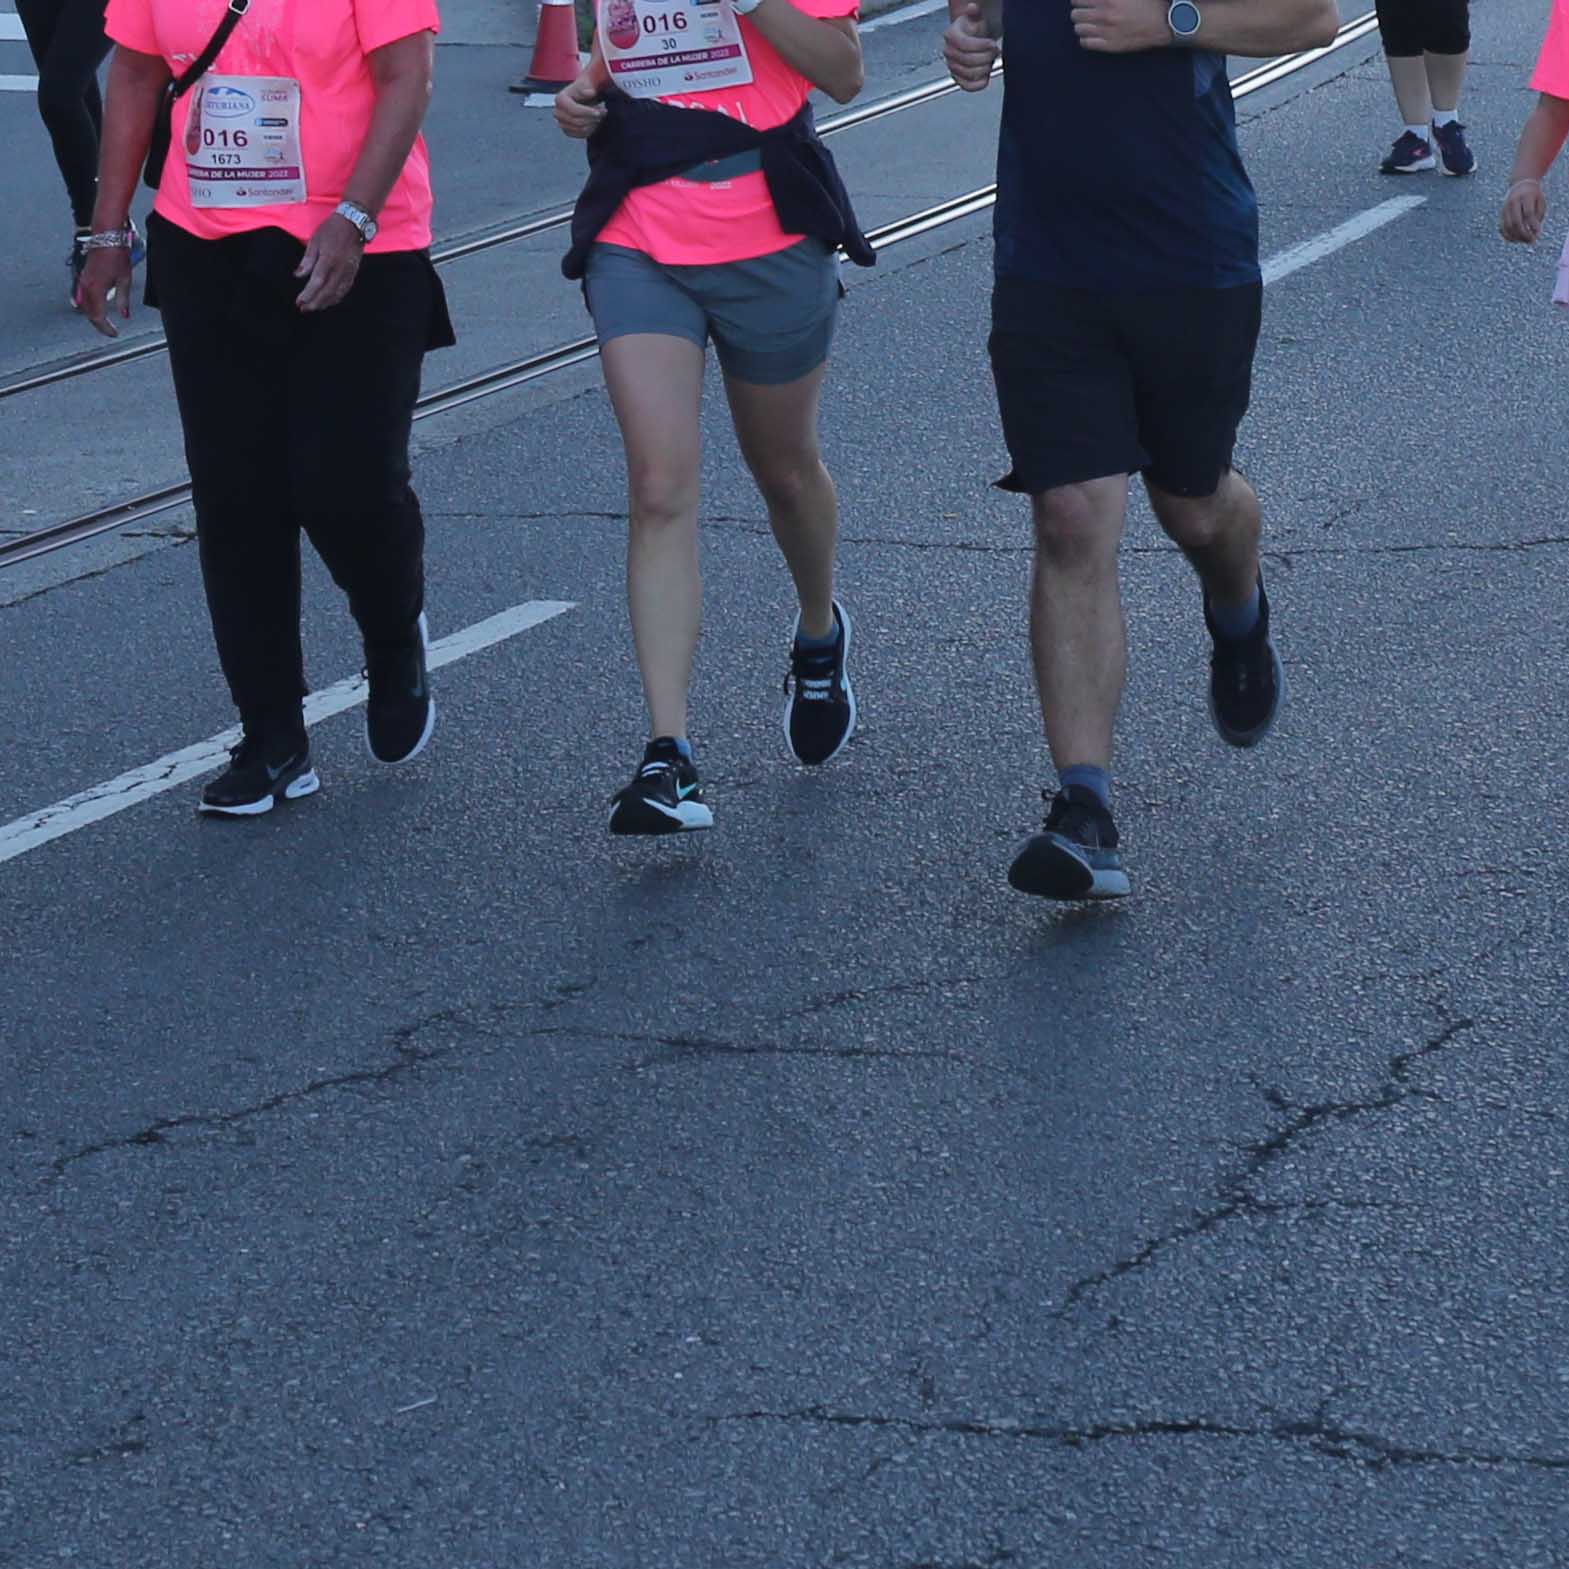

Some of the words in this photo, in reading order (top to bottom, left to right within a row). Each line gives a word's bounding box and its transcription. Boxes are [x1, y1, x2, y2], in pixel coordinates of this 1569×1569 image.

[643, 11, 688, 34] 016
[661, 38, 678, 51] 30
[657, 57, 668, 67] DE
[670, 56, 681, 65] LA
[622, 77, 662, 89] OYSHO
[203, 128, 248, 147] 016
[211, 153, 242, 165] 1673
